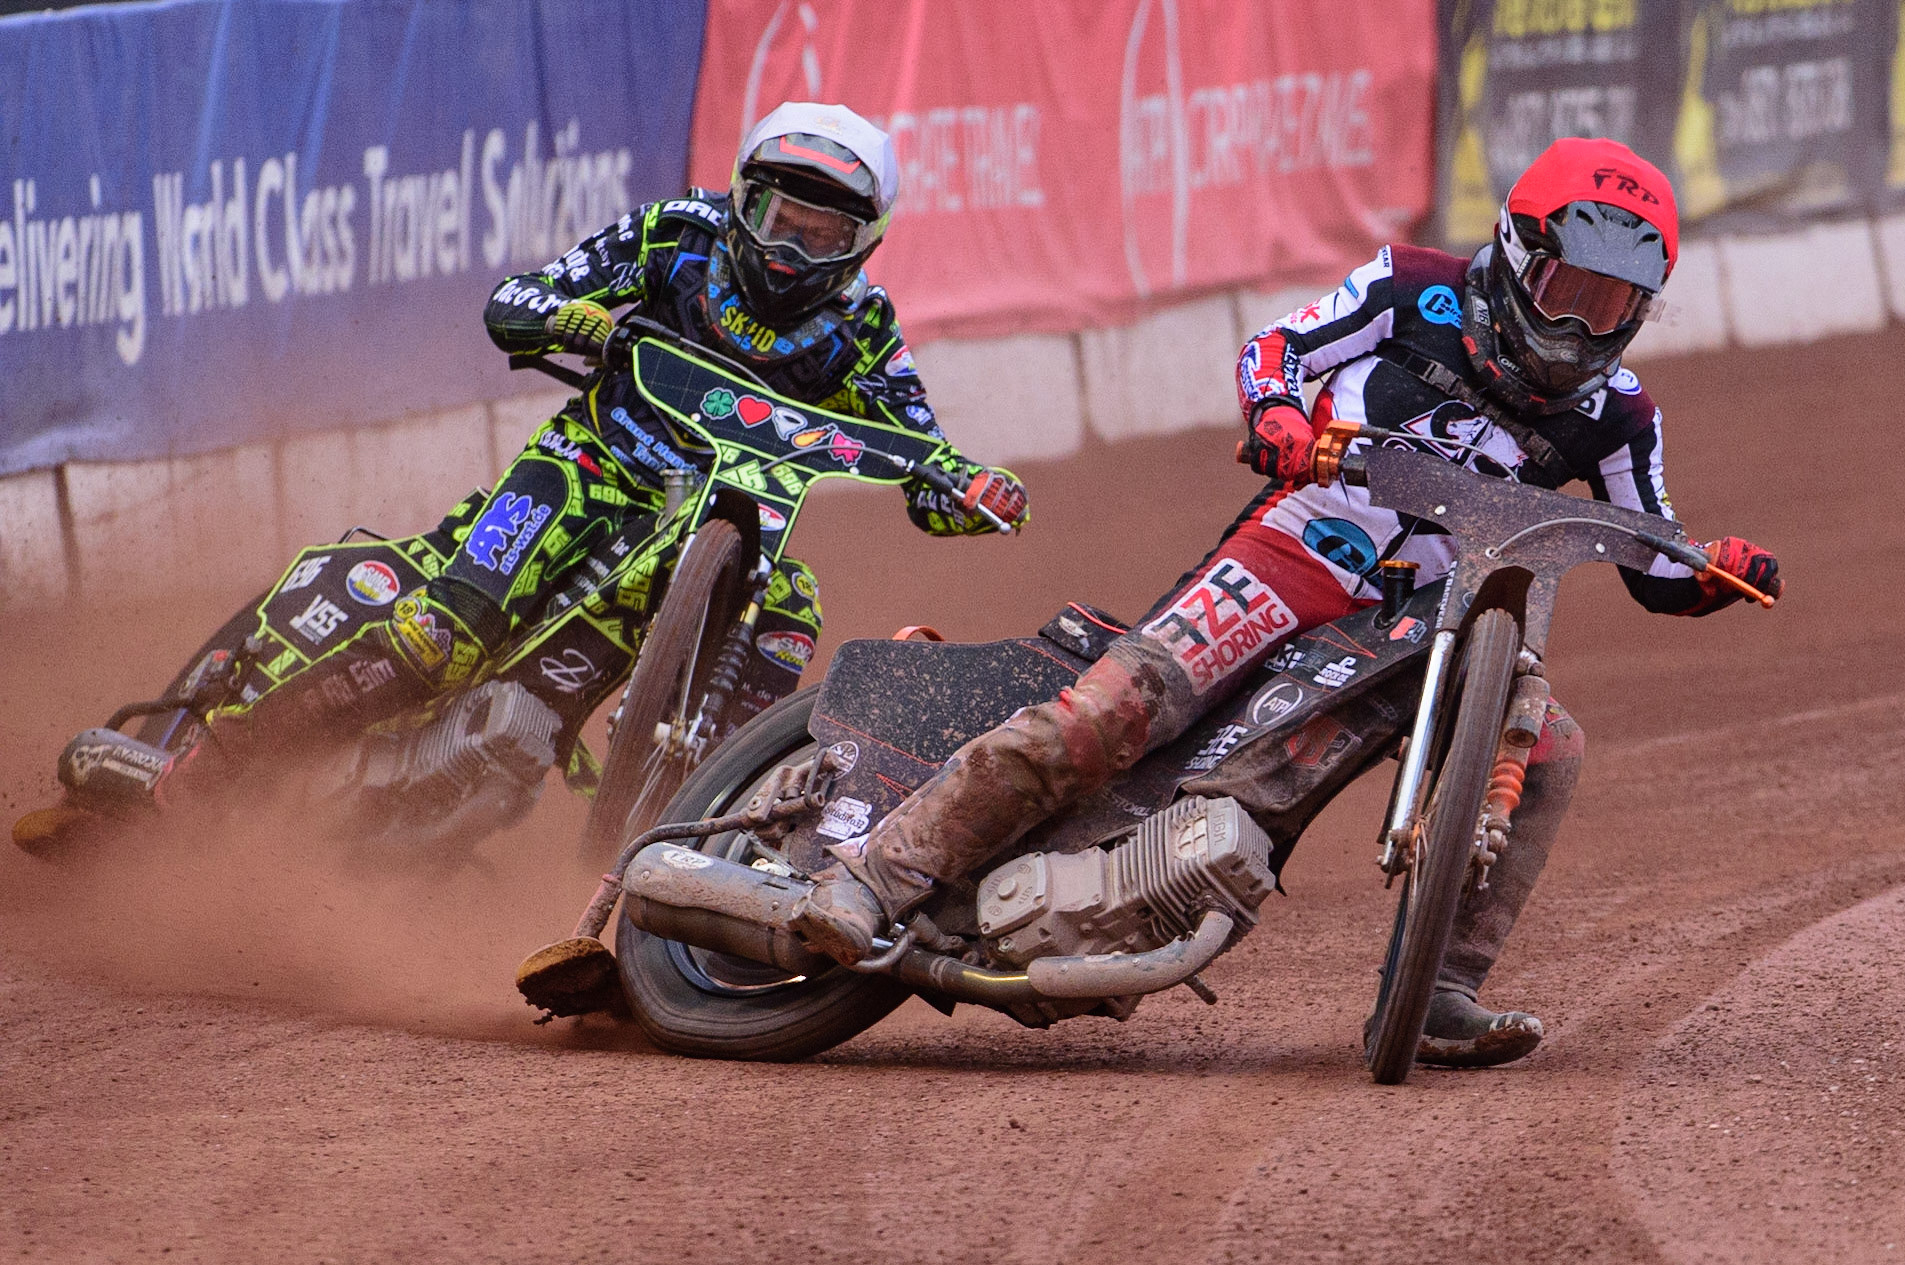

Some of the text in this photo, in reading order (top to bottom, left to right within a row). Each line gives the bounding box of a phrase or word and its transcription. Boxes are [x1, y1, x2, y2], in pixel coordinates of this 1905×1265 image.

[256, 152, 356, 299] Class
[363, 129, 474, 285] Travel
[289, 593, 349, 638] YSS
[1190, 602, 1290, 690] SHORING
